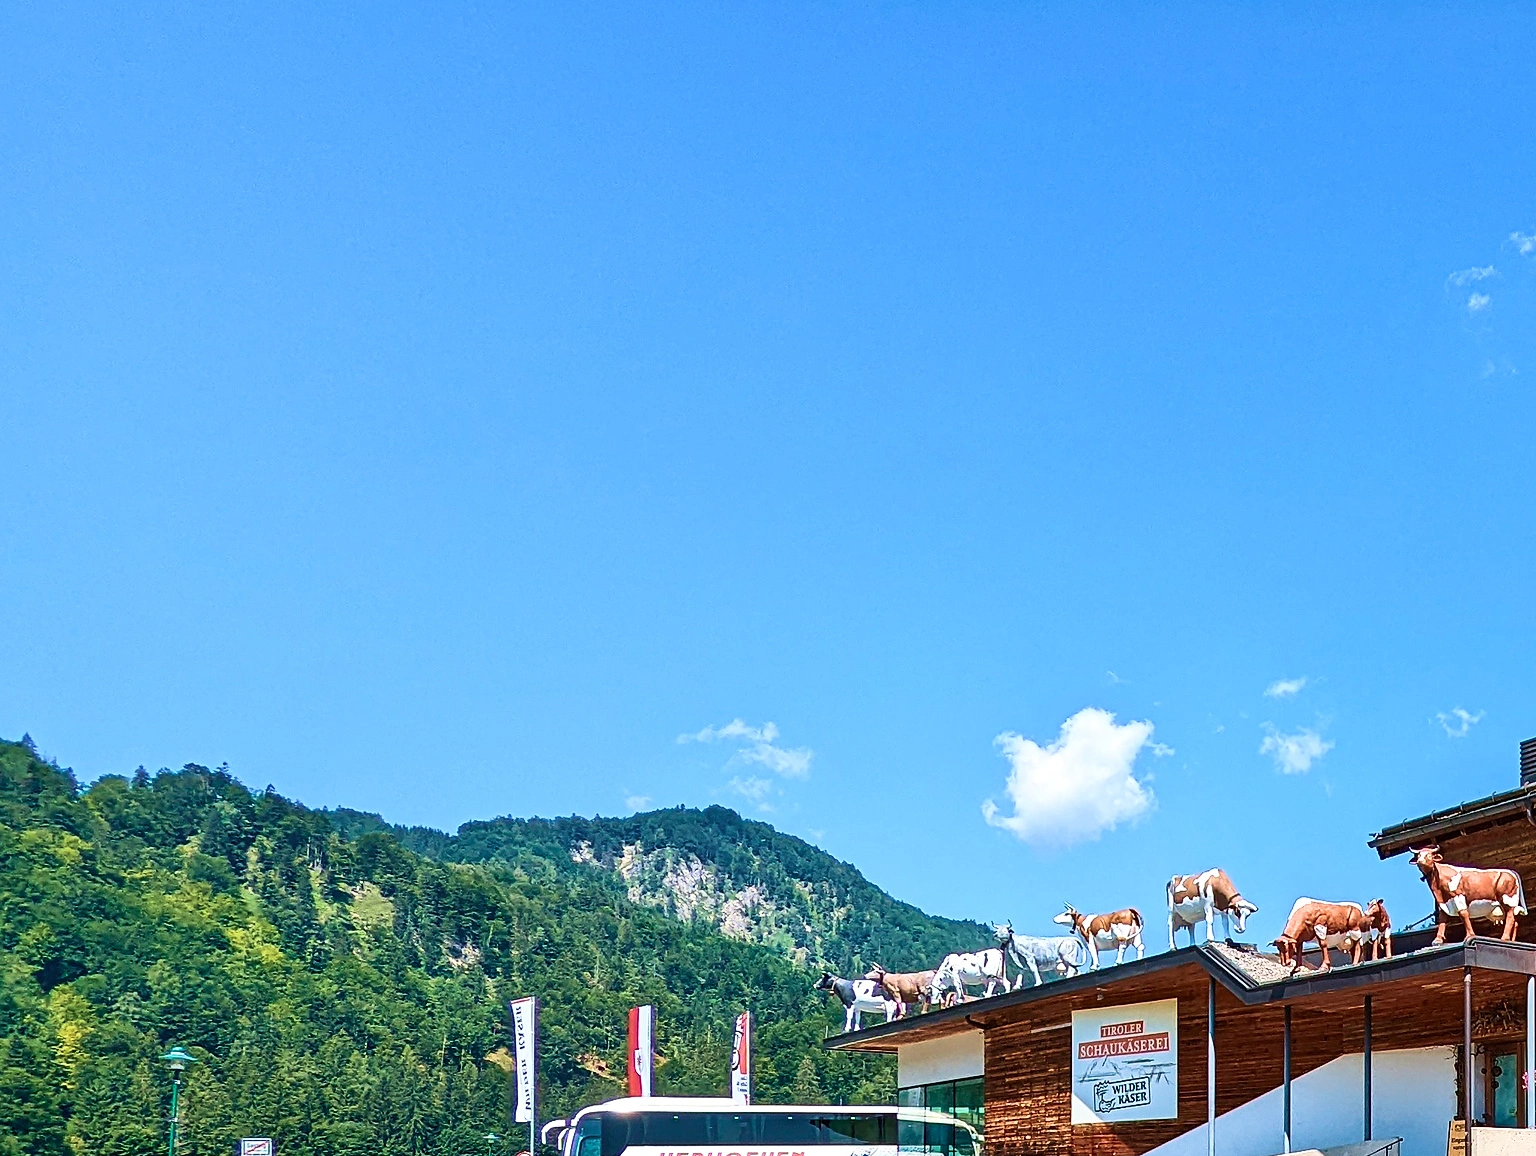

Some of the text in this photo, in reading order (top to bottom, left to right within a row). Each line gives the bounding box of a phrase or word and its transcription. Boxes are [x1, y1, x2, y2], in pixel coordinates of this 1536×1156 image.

[1101, 1023, 1142, 1037] TIROLER
[1080, 1037, 1169, 1058] SCHAUKÄSEREI
[1112, 1081, 1147, 1094] WILDER
